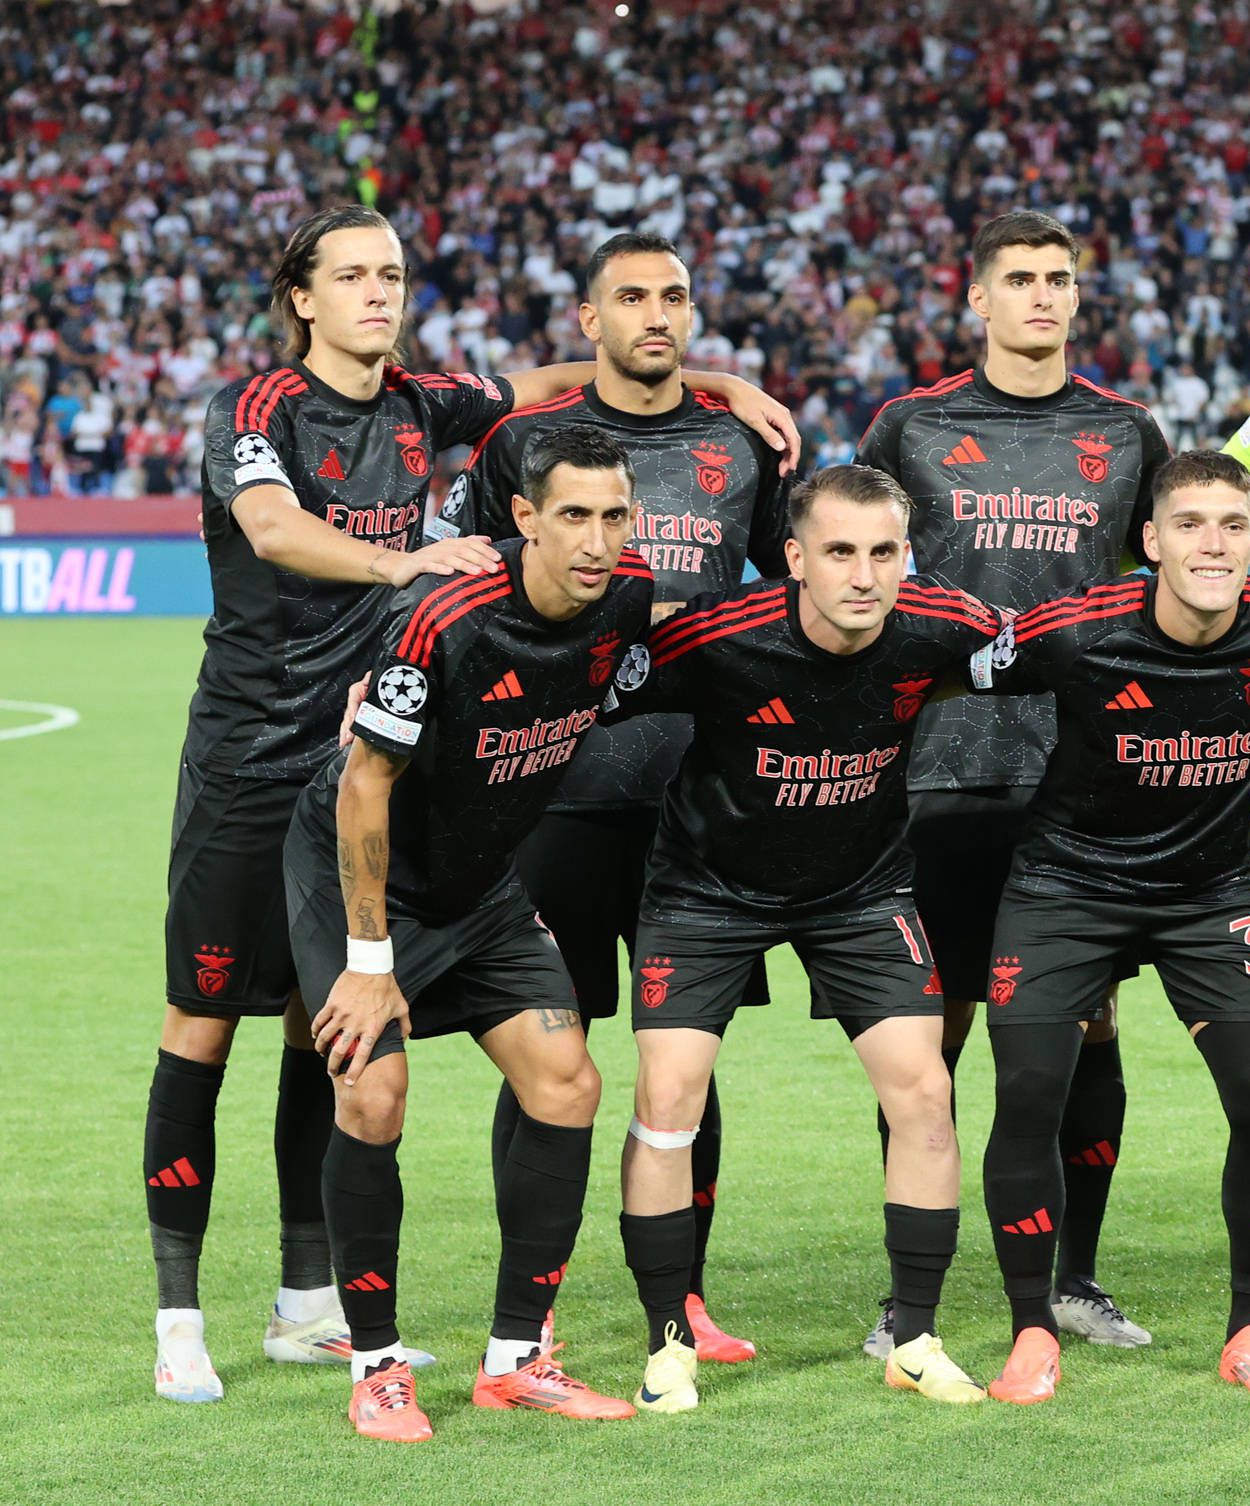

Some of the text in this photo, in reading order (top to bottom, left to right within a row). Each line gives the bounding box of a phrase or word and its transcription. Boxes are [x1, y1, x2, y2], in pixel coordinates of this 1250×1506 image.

[632, 506, 722, 546] irates
[951, 486, 1099, 528] Emirates
[974, 523, 1080, 554] FLY BETTER
[476, 704, 600, 759] Emirates
[487, 738, 577, 785] FLY BETTER
[756, 740, 902, 780] Emirates
[1137, 758, 1250, 787] FLY BETTER
[775, 771, 881, 807] FLY BETTER
